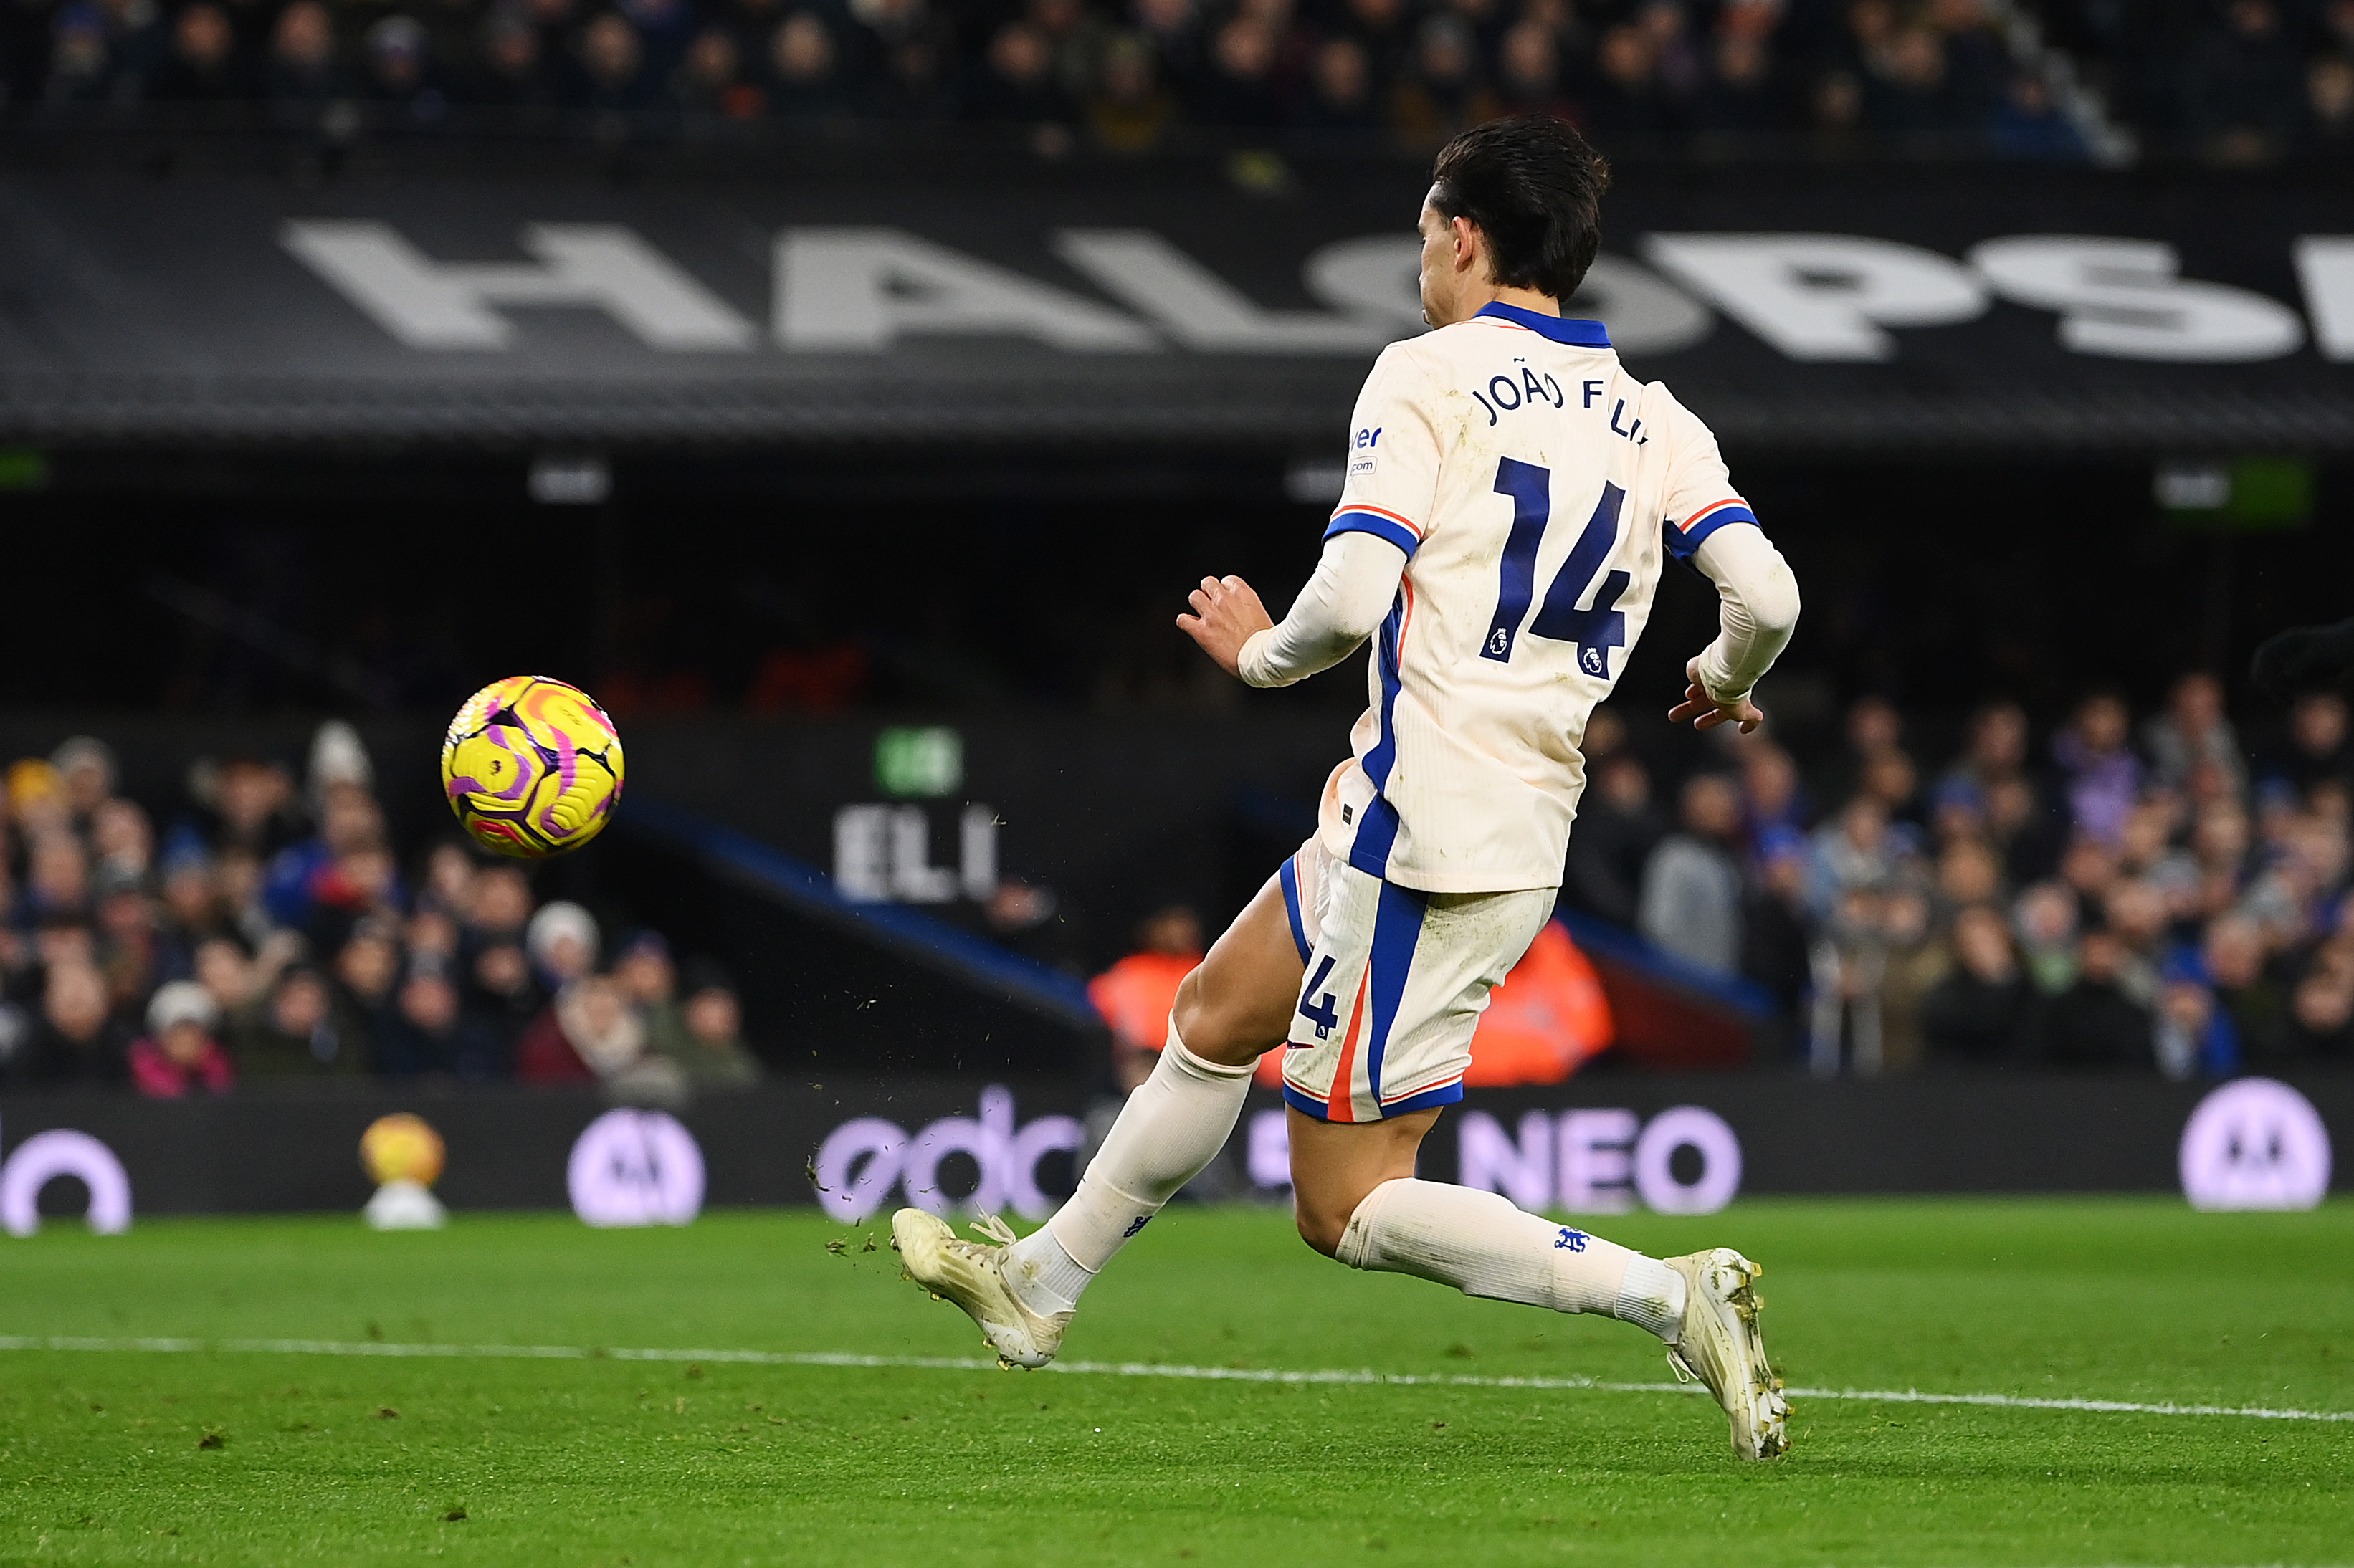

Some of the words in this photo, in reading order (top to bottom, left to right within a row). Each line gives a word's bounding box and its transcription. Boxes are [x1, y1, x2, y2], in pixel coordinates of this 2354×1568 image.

[1472, 356, 1564, 426] JOÃO
[1479, 455, 1631, 681] 14
[1298, 955, 1338, 1041] 4
